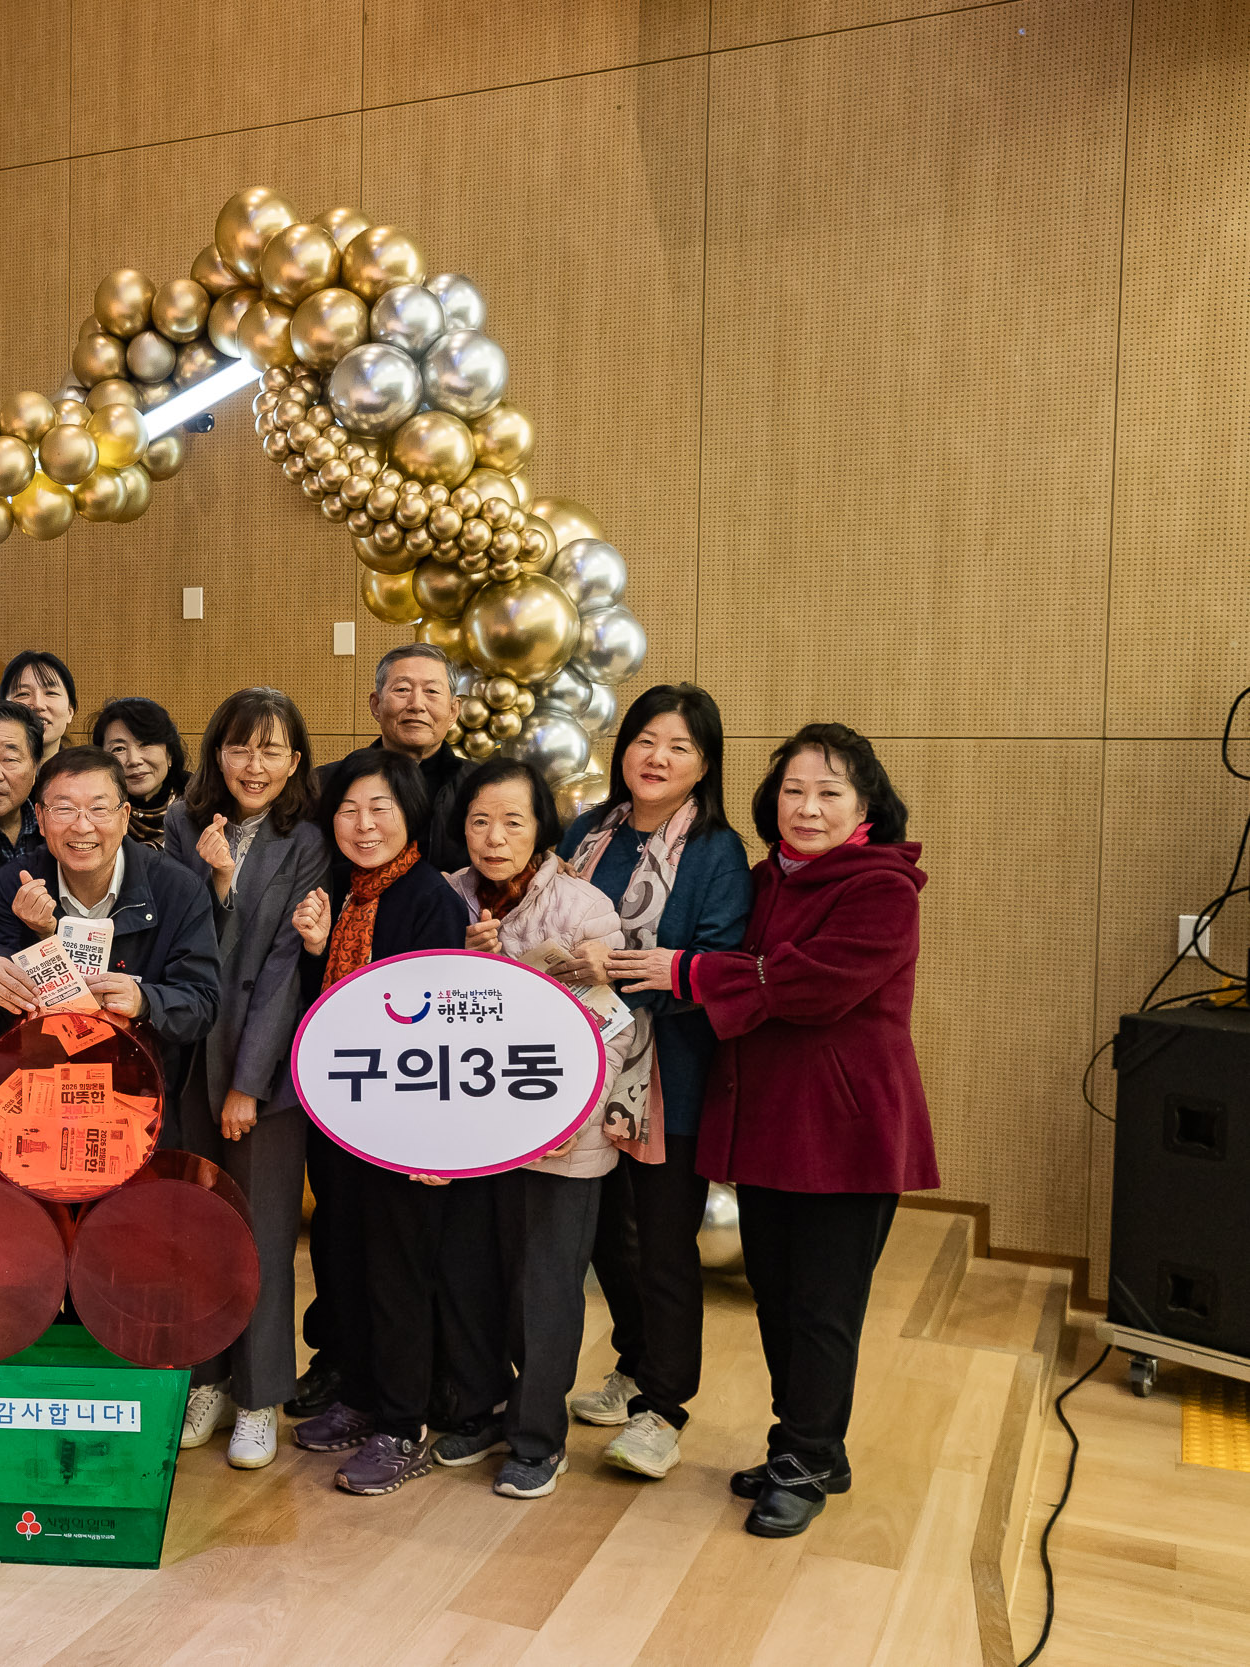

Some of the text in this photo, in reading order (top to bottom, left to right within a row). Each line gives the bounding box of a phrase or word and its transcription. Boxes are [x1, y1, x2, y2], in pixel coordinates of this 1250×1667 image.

[62, 940, 78, 949] 2026
[437, 989, 502, 1003] 소통하며 발전하는
[437, 1001, 503, 1024] 행복광진
[328, 1044, 564, 1102] 구의3동
[61, 1083, 78, 1091] 2026
[61, 1090, 106, 1105] 따뜻한
